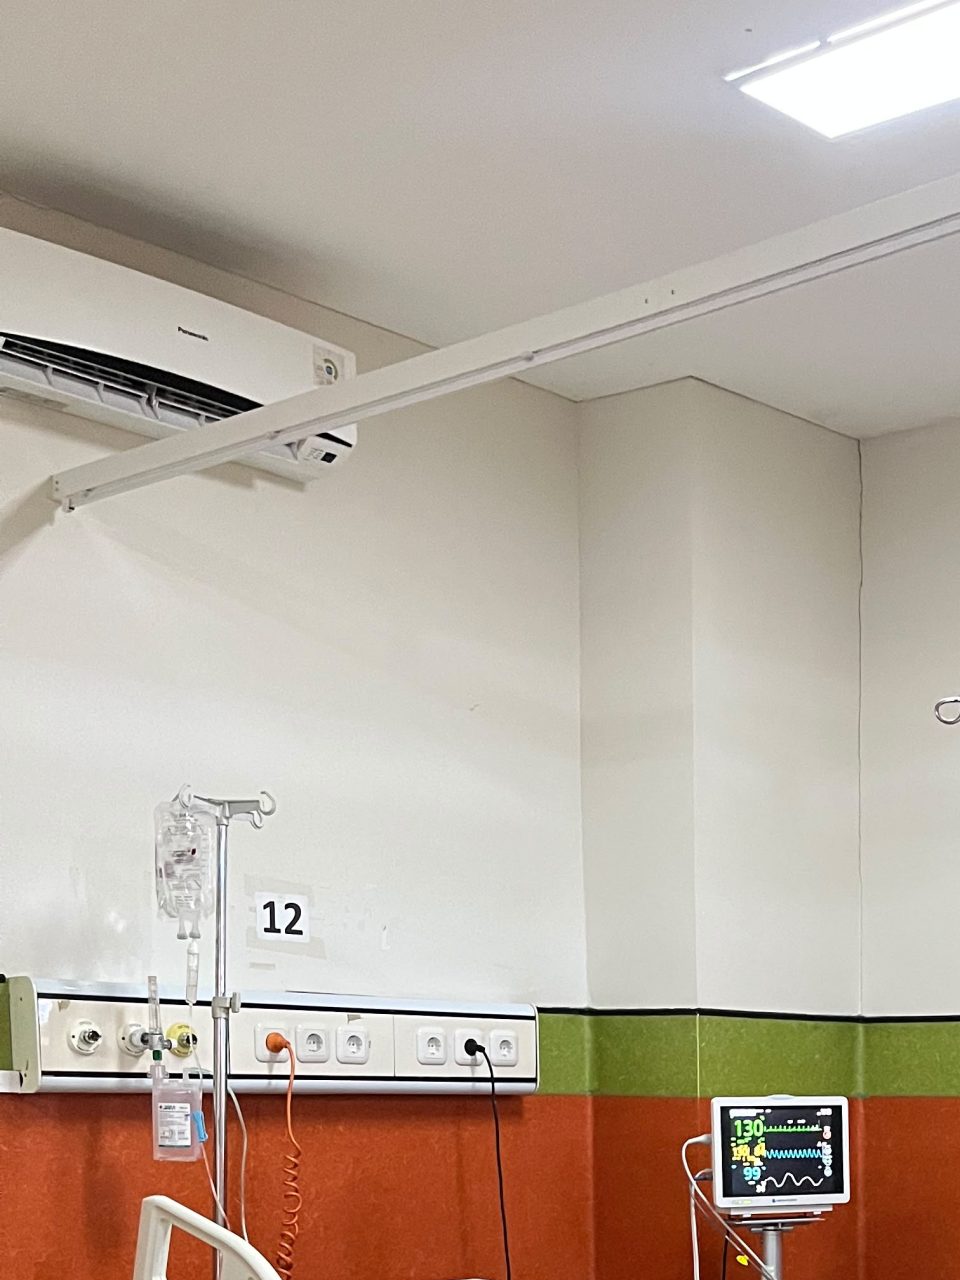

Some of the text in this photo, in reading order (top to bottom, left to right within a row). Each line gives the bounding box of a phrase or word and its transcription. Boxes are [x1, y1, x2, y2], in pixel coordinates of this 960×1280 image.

[263, 900, 304, 936] 12
[734, 1119, 764, 1137] 130
[743, 1166, 762, 1181] 99
